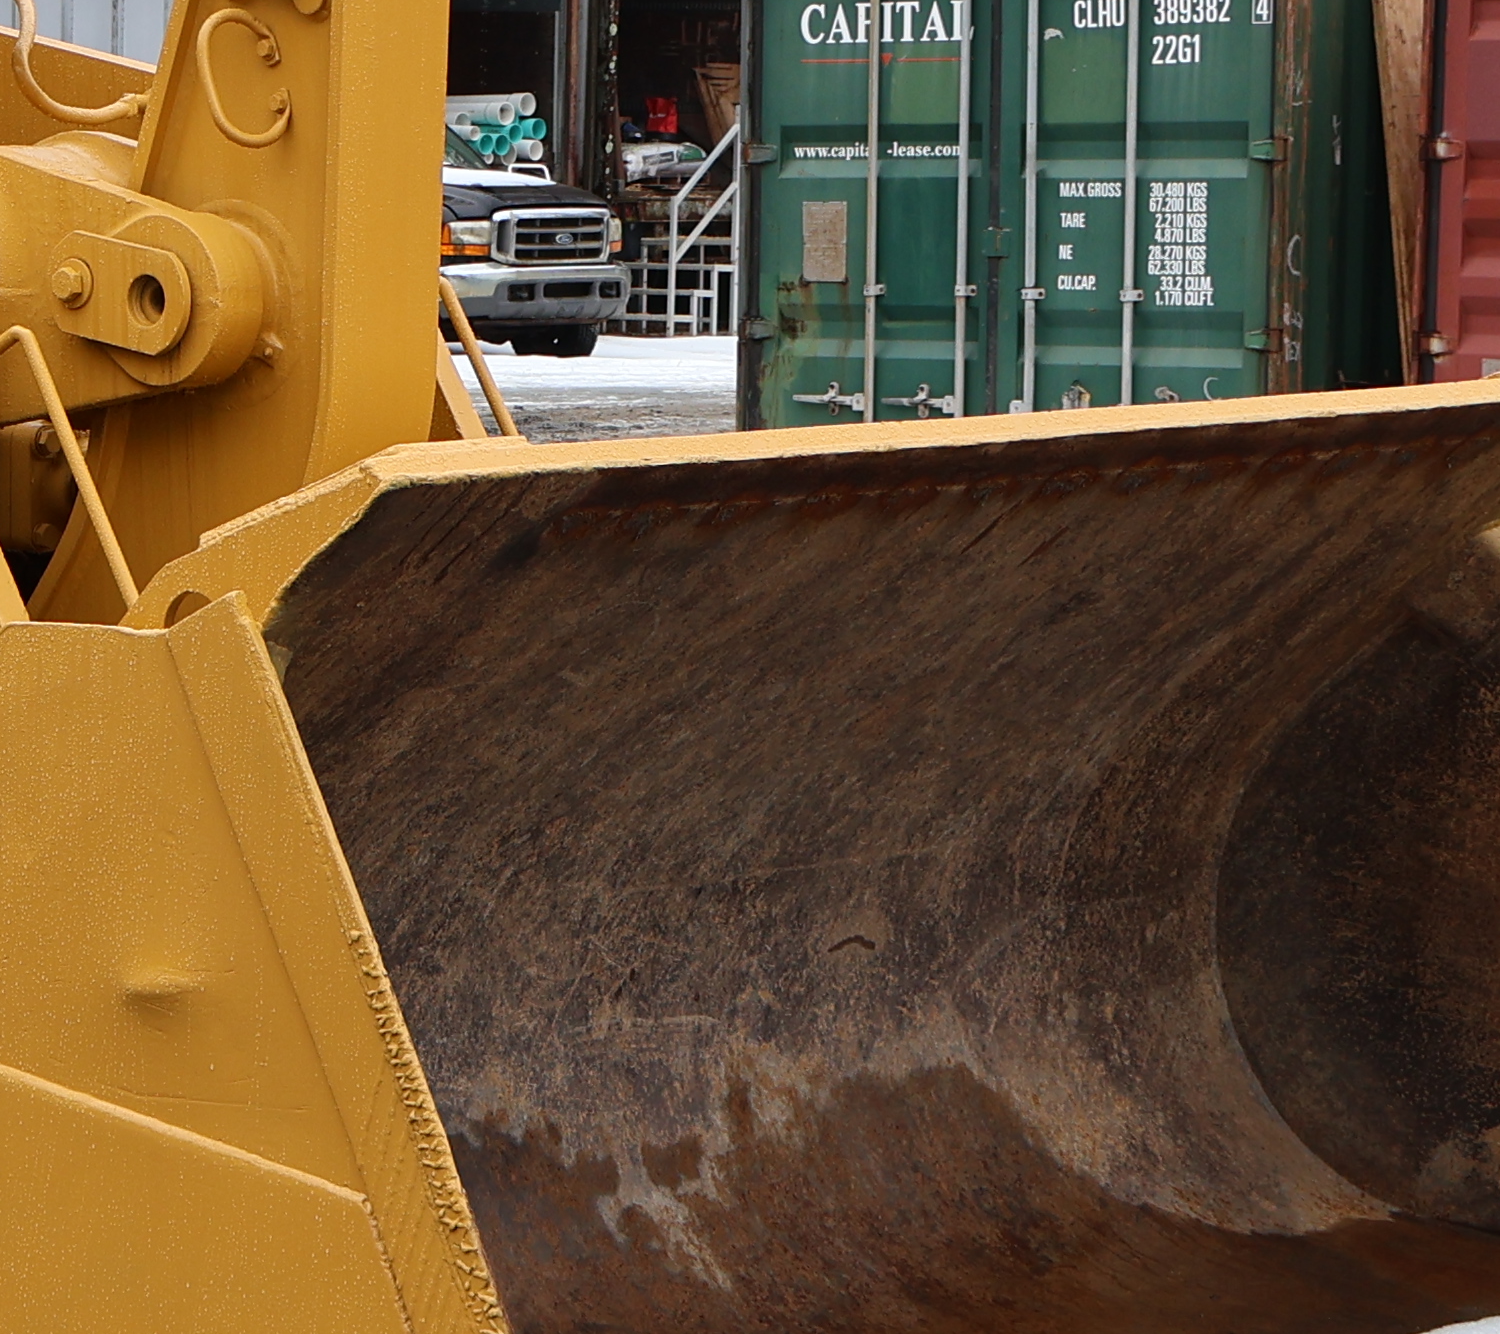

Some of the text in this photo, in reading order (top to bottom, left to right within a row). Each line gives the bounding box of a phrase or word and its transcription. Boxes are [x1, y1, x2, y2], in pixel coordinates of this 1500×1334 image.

[1151, 34, 1201, 65] 22G1
[1150, 182, 1184, 197] 30.480
[1186, 182, 1208, 197] KGS
[1149, 198, 1207, 212] 67.200 LBS
[1060, 213, 1208, 228] TARE 2.210 KGS
[1155, 229, 1206, 243] 4.870 LBS
[1059, 245, 1207, 260] NE 28.270 KGS
[1148, 261, 1205, 275] 62.330 LBS
[1160, 276, 1183, 291] 33.2
[1155, 292, 1182, 306] 1.170
